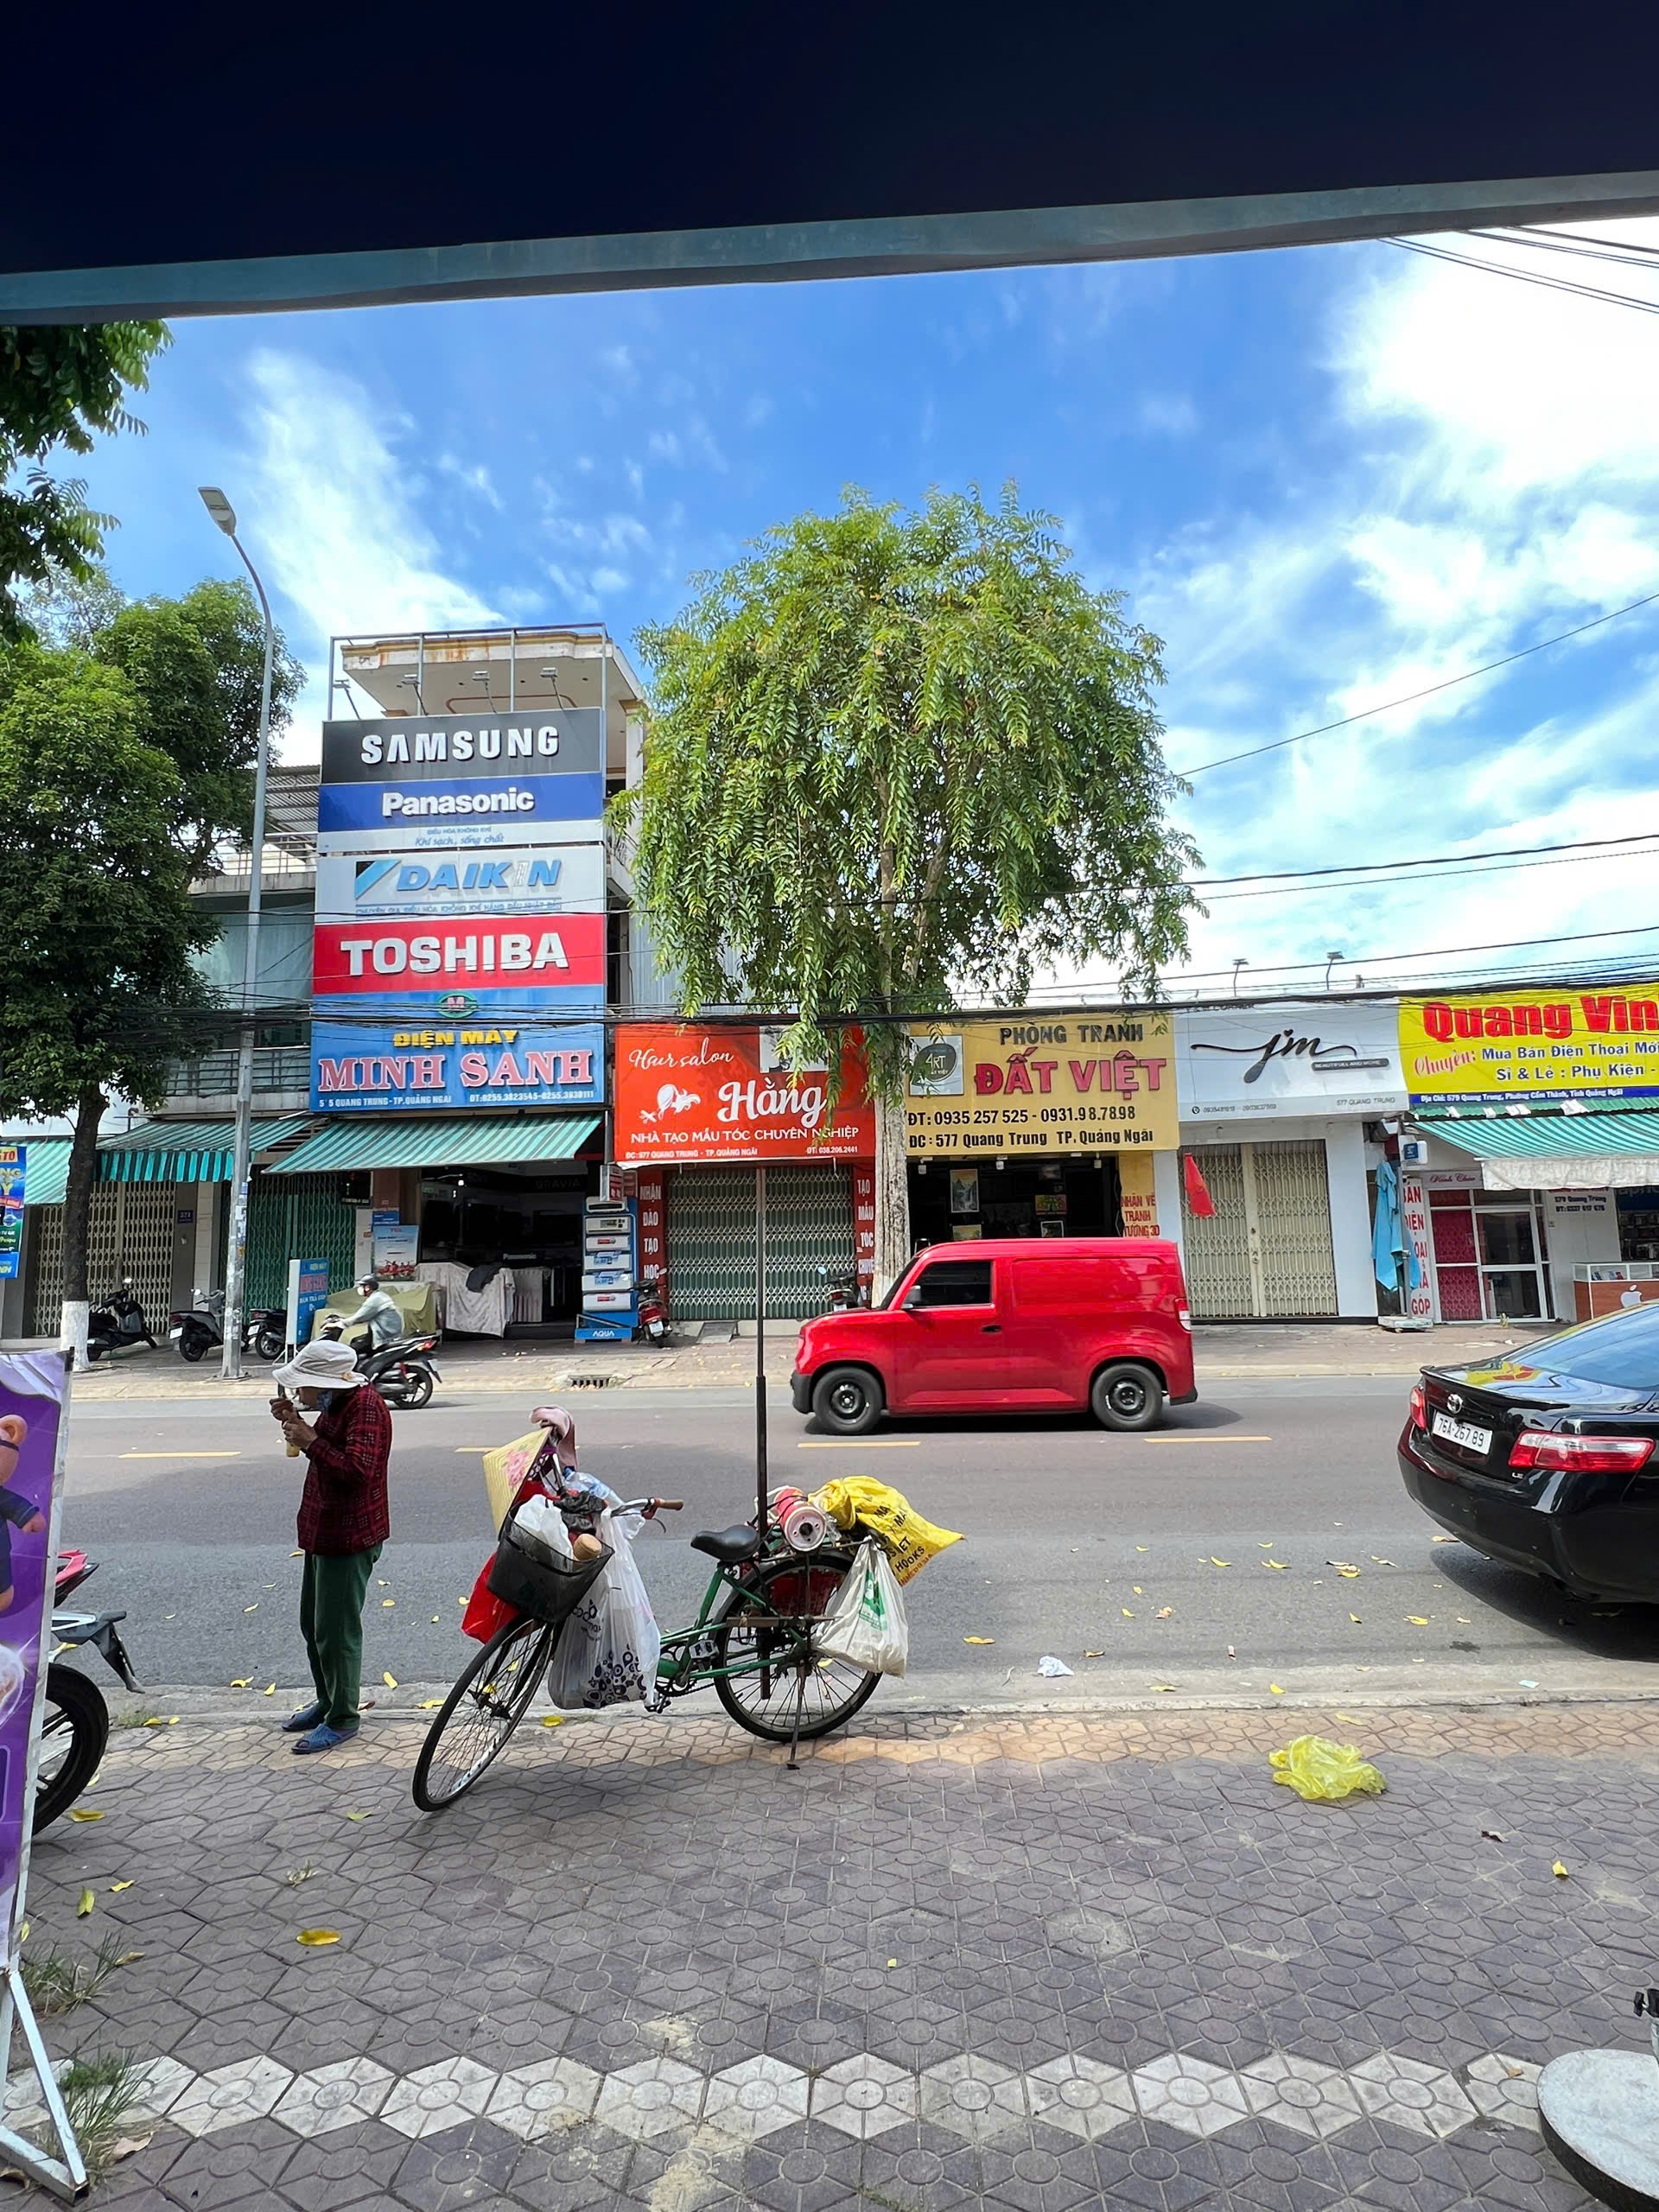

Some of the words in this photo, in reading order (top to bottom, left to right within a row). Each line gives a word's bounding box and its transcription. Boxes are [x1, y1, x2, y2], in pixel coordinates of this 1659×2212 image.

[361, 726, 560, 765] SAMSUNG
[382, 787, 535, 817] Panasonic
[340, 932, 569, 976] TOSHIBA
[1422, 1001, 1573, 1043] Quang
[1580, 995, 1659, 1033] Vin
[1000, 1023, 1067, 1045] PHÒNG
[1077, 1023, 1143, 1044] TRANH
[680, 1037, 734, 1068] salon
[1482, 1048, 1512, 1060] Mua
[1517, 1046, 1545, 1059] Bán
[1551, 1046, 1583, 1058] Điện
[1588, 1042, 1629, 1057] Thoại
[318, 1054, 447, 1092] MINH
[460, 1050, 594, 1088] SANH
[974, 1046, 1058, 1095] ĐẤT
[1068, 1049, 1166, 1100] VIỆT
[1517, 1068, 1529, 1079] &
[1572, 1065, 1601, 1080] Phụ
[1608, 1063, 1644, 1078] Kiện
[335, 1097, 362, 1107] QUANG
[363, 1096, 389, 1106] TRUNG
[716, 1077, 828, 1128] Hằng
[934, 1109, 970, 1125] 0935
[973, 1109, 999, 1124] 257
[1001, 1109, 1028, 1123] 525
[631, 1128, 661, 1143] NHÀ
[664, 1131, 689, 1145] TẠO
[725, 1127, 751, 1141] TÓC
[754, 1127, 807, 1141] CHUYÊN
[812, 1125, 859, 1140] NGHIỆP
[936, 1133, 958, 1147] 577
[963, 1133, 1005, 1147] Quang
[1008, 1131, 1048, 1147] Trung
[1056, 1130, 1077, 1145] TP.
[1079, 1128, 1120, 1146] Quảng
[1124, 1128, 1154, 1144] Ngãi
[857, 1179, 871, 1197] TẠO
[1124, 1211, 1151, 1223] TRANH
[644, 1237, 658, 1255] TẠO
[860, 1229, 874, 1248] TÓC
[1411, 1294, 1431, 1315] GÓP
[894, 1545, 925, 1573] HOOKS
